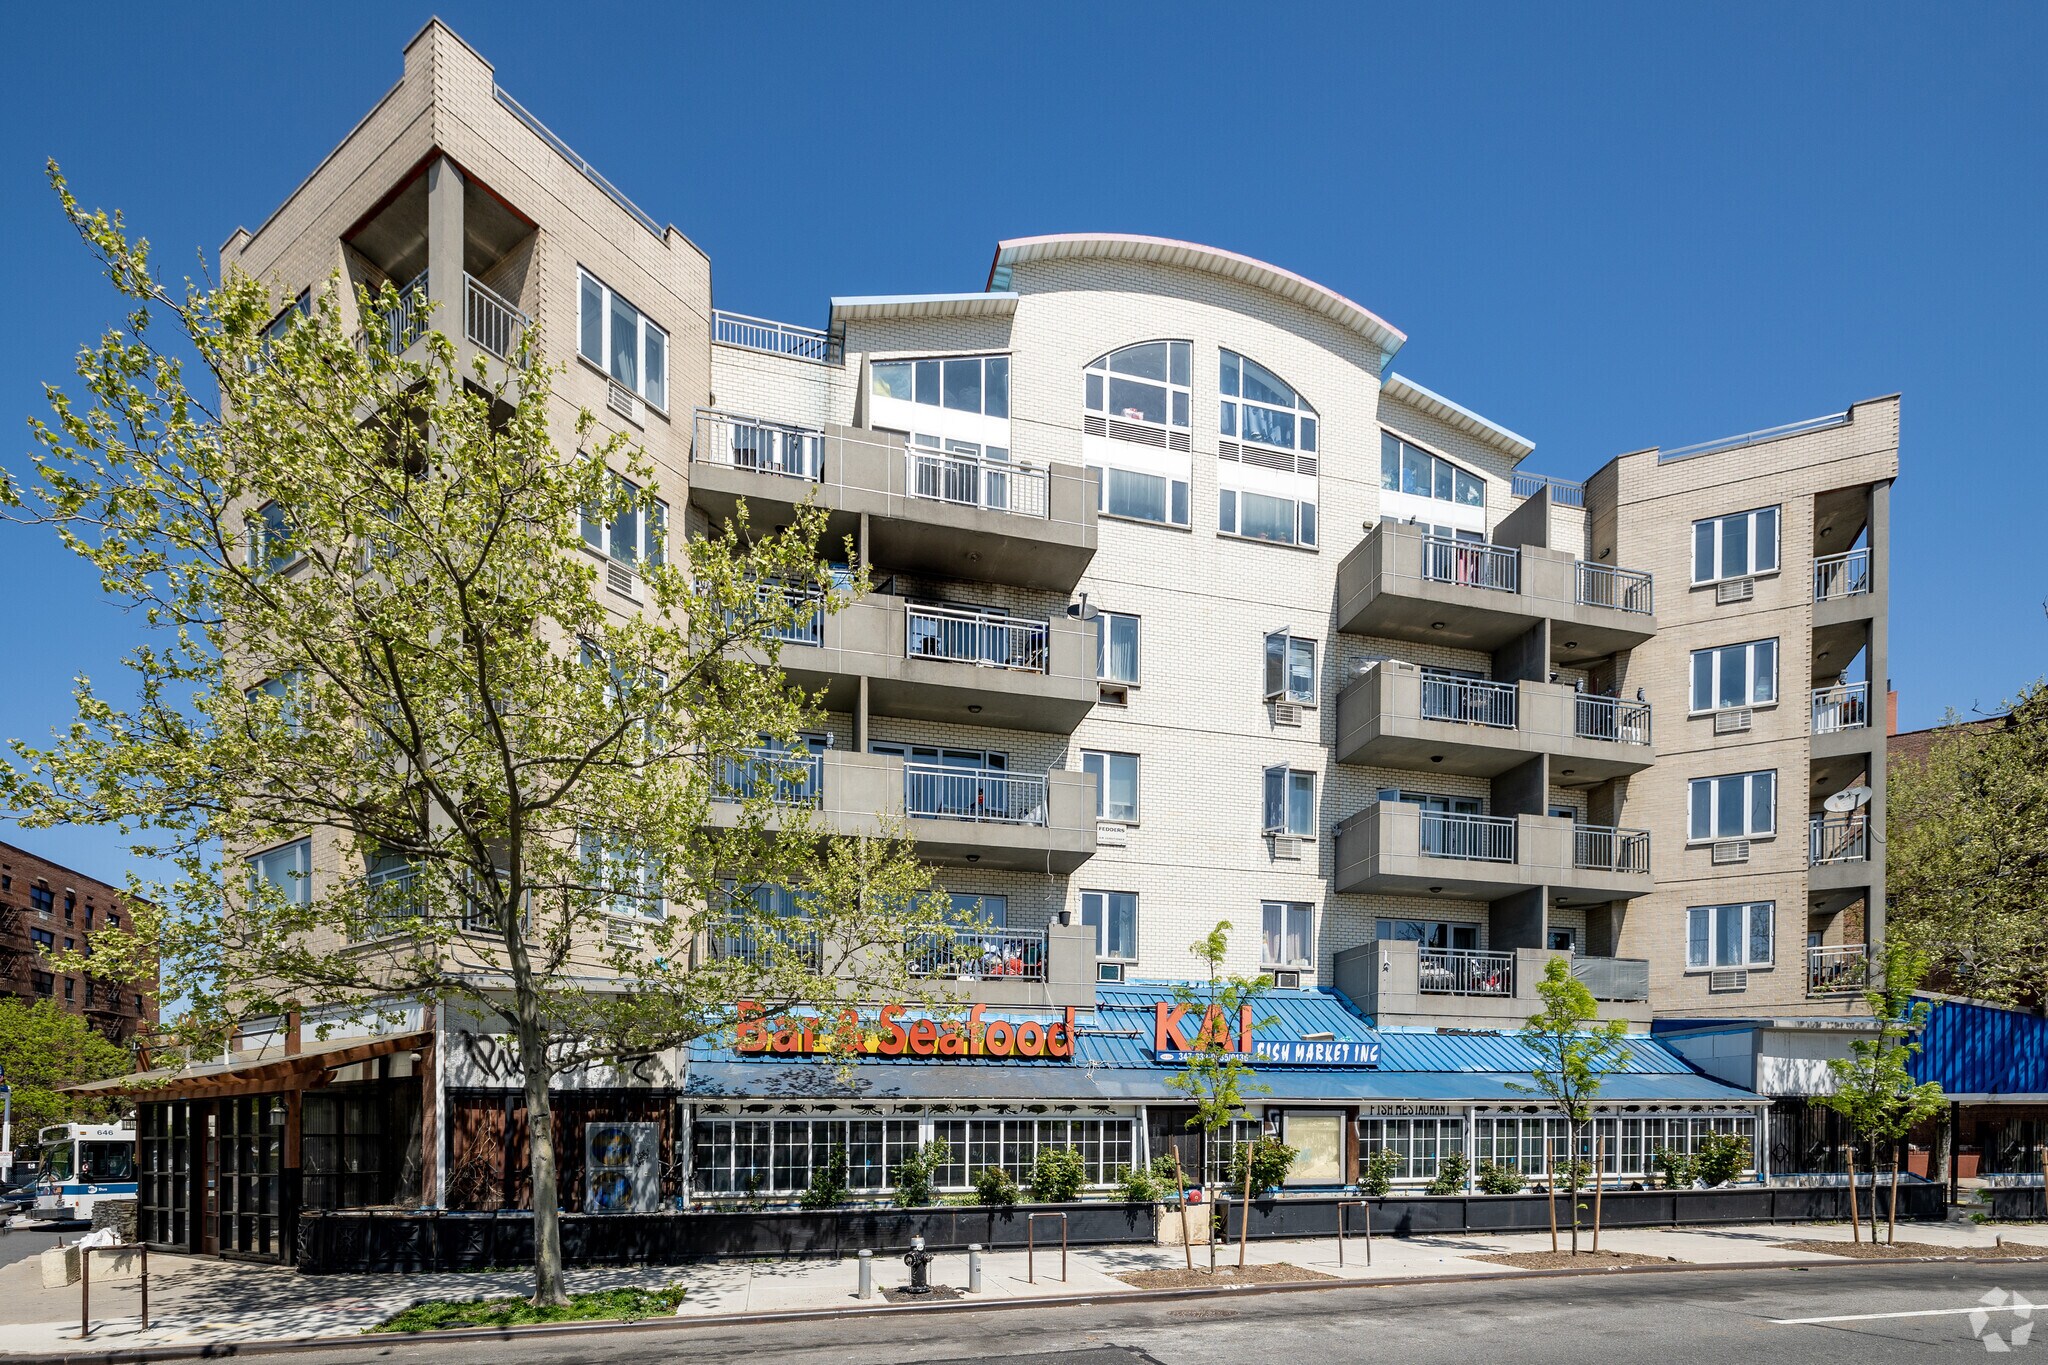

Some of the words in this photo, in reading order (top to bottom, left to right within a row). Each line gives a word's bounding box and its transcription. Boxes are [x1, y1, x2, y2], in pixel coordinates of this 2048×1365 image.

[736, 1000, 820, 1053] Bar
[835, 1008, 868, 1053] &
[877, 1003, 1076, 1057] Seafood
[1155, 1001, 1252, 1053] KAI
[1256, 1041, 1291, 1063] FISH
[1295, 1042, 1350, 1063] MARKET
[1354, 1043, 1379, 1063] INC
[1370, 1104, 1393, 1116] FISH
[1395, 1104, 1450, 1116] RESTAURANT
